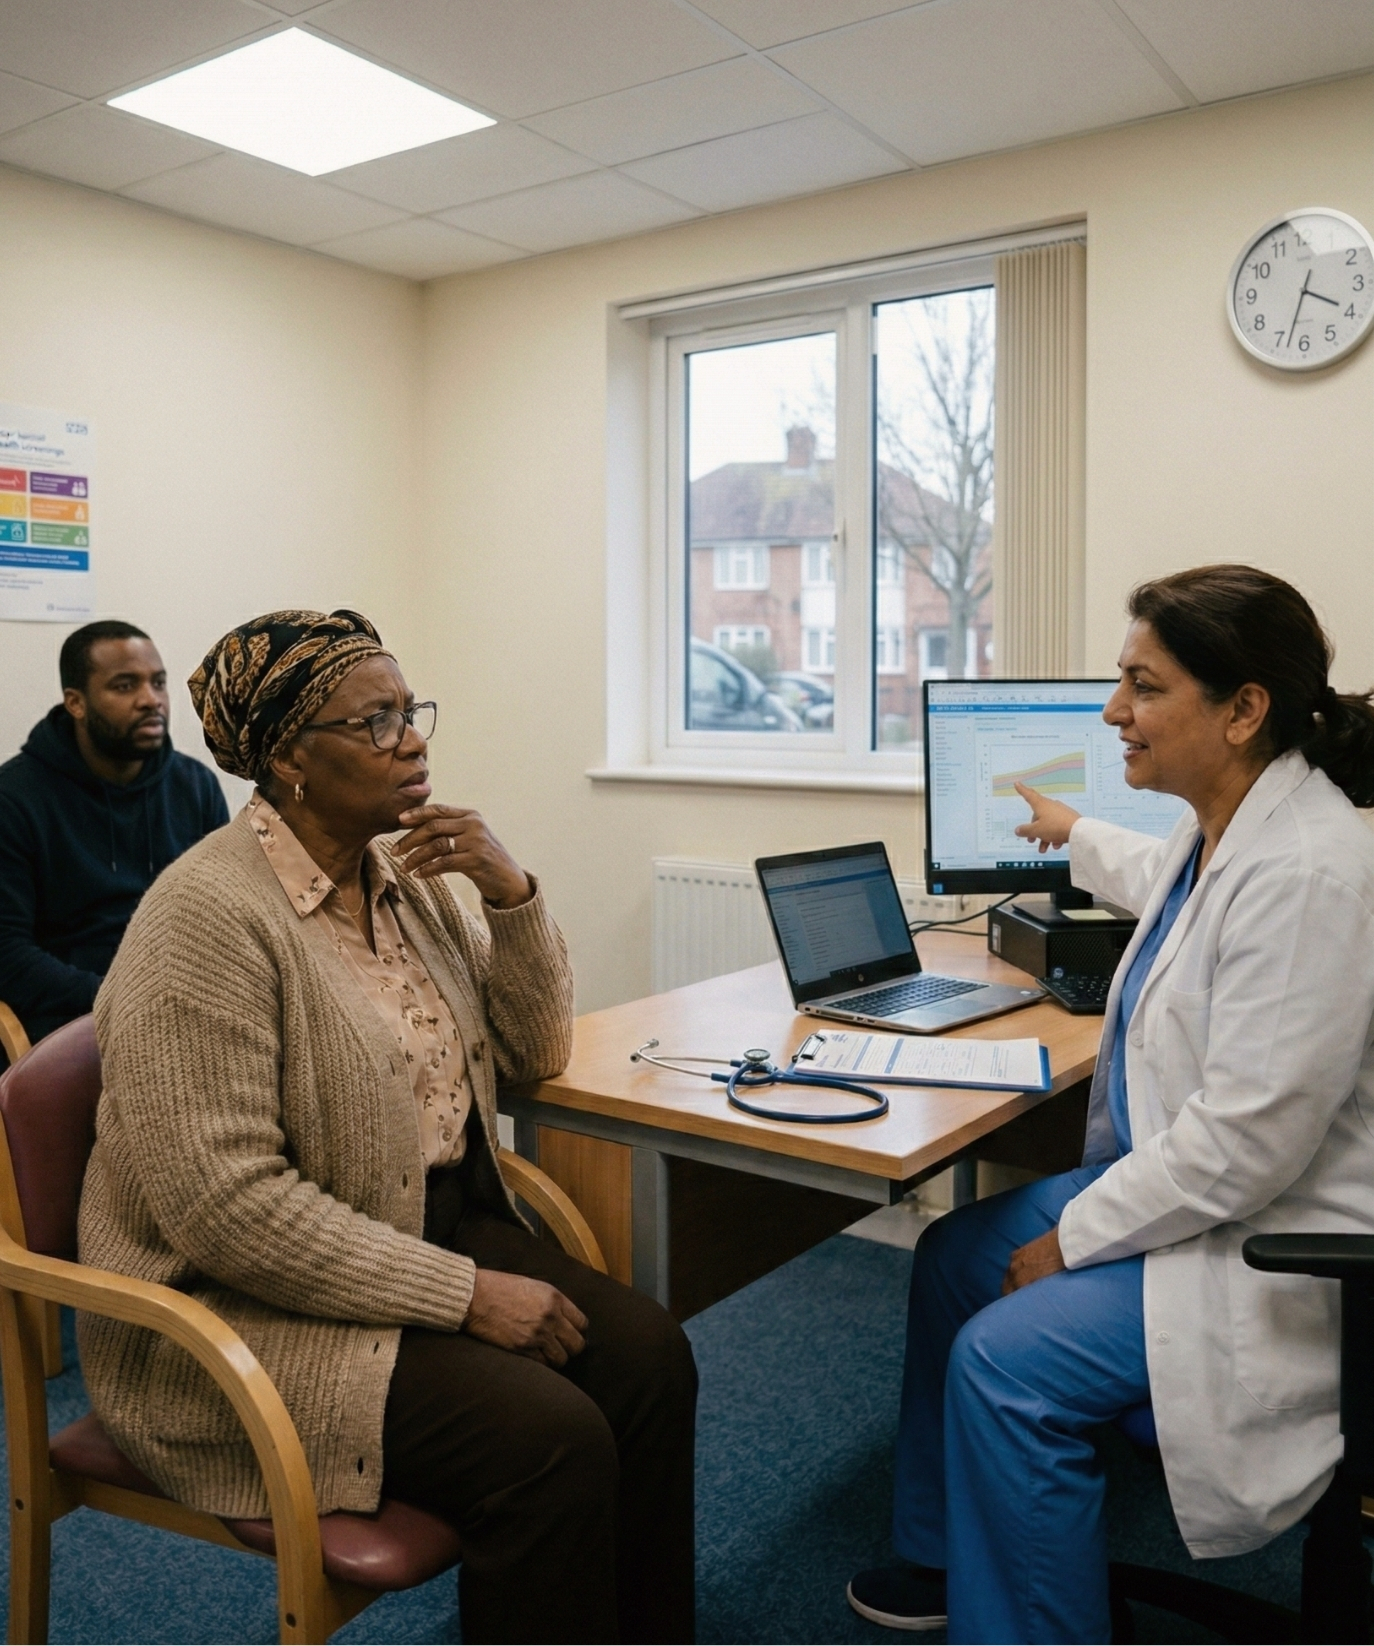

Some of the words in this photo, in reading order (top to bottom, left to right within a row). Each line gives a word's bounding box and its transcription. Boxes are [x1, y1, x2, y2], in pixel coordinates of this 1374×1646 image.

[1271, 240, 1286, 258] 11
[1345, 248, 1358, 265] 2
[1251, 262, 1271, 280] 10
[1352, 274, 1365, 291] 3
[1246, 288, 1258, 305] 9
[1344, 302, 1356, 320] 4
[1254, 314, 1266, 331] 8
[1274, 331, 1286, 348] 7
[1324, 324, 1337, 342] 5
[1298, 335, 1311, 351] 6
